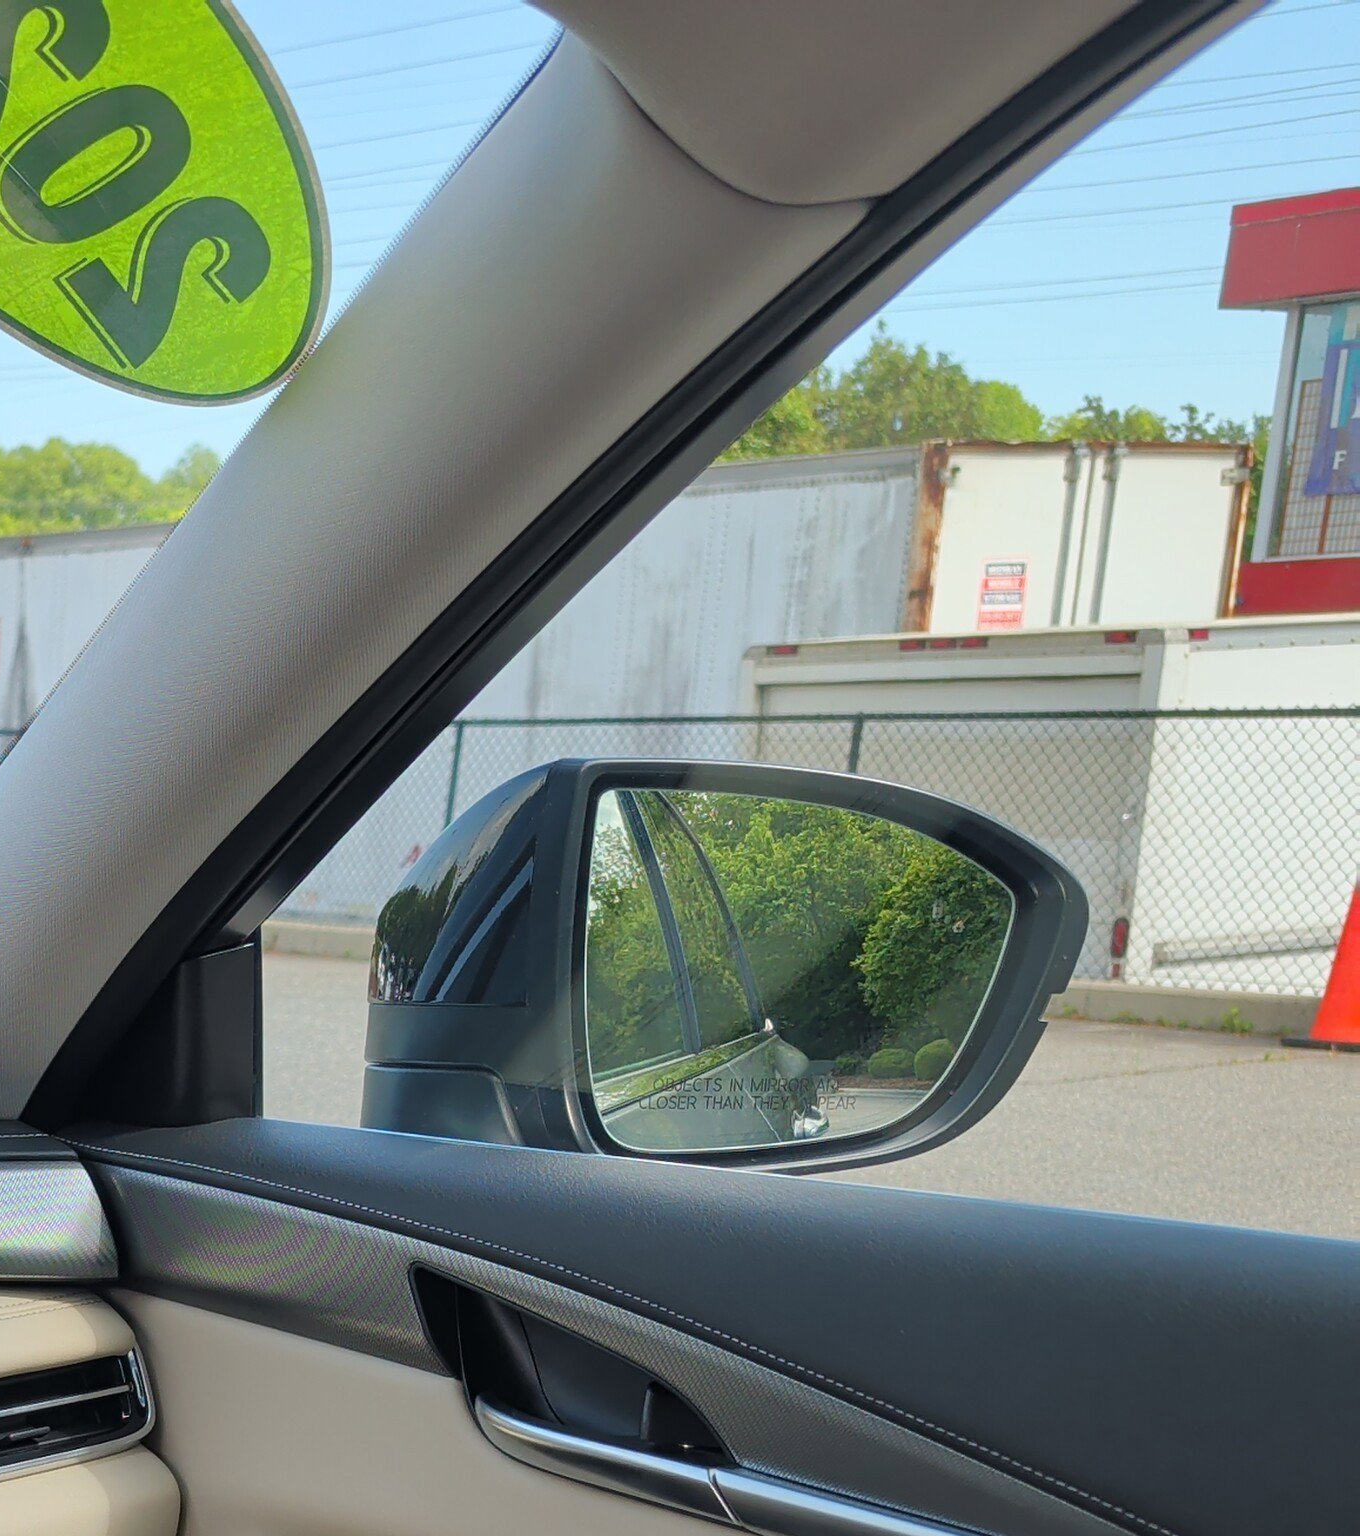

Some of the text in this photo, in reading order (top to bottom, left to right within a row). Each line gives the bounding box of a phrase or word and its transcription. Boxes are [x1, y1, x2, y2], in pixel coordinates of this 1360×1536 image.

[652, 1077, 723, 1093] OBJECTS
[729, 1077, 744, 1092] IN
[749, 1077, 810, 1093] MIRROR
[638, 1094, 857, 1110] CLOSER THAN THEY APEAR
